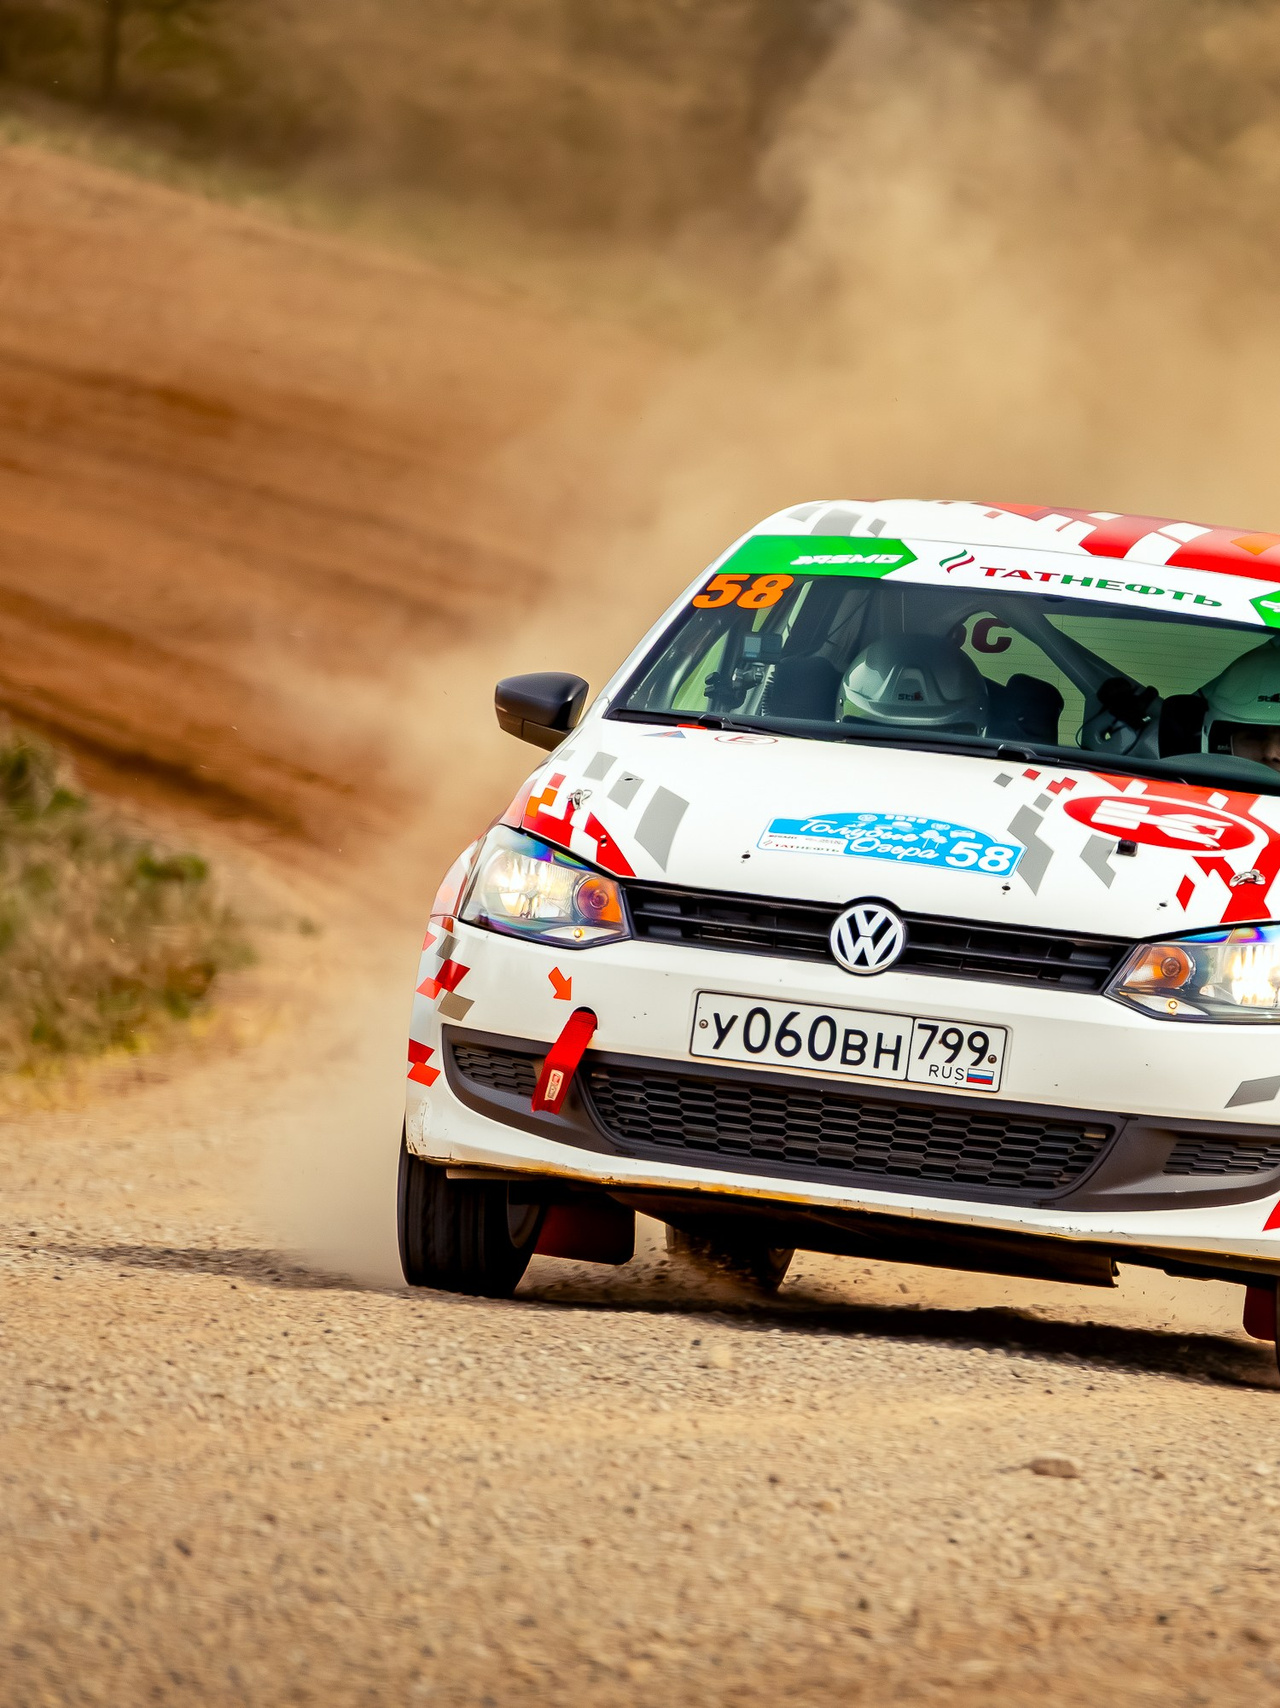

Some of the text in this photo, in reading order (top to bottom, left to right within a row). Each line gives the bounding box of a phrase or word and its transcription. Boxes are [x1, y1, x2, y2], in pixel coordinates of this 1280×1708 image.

[692, 574, 794, 609] 58
[979, 566, 1223, 607] ТАТНЕФТЬ
[945, 841, 1015, 873] 58
[916, 1022, 990, 1067] 799
[928, 1063, 965, 1081] RUS
